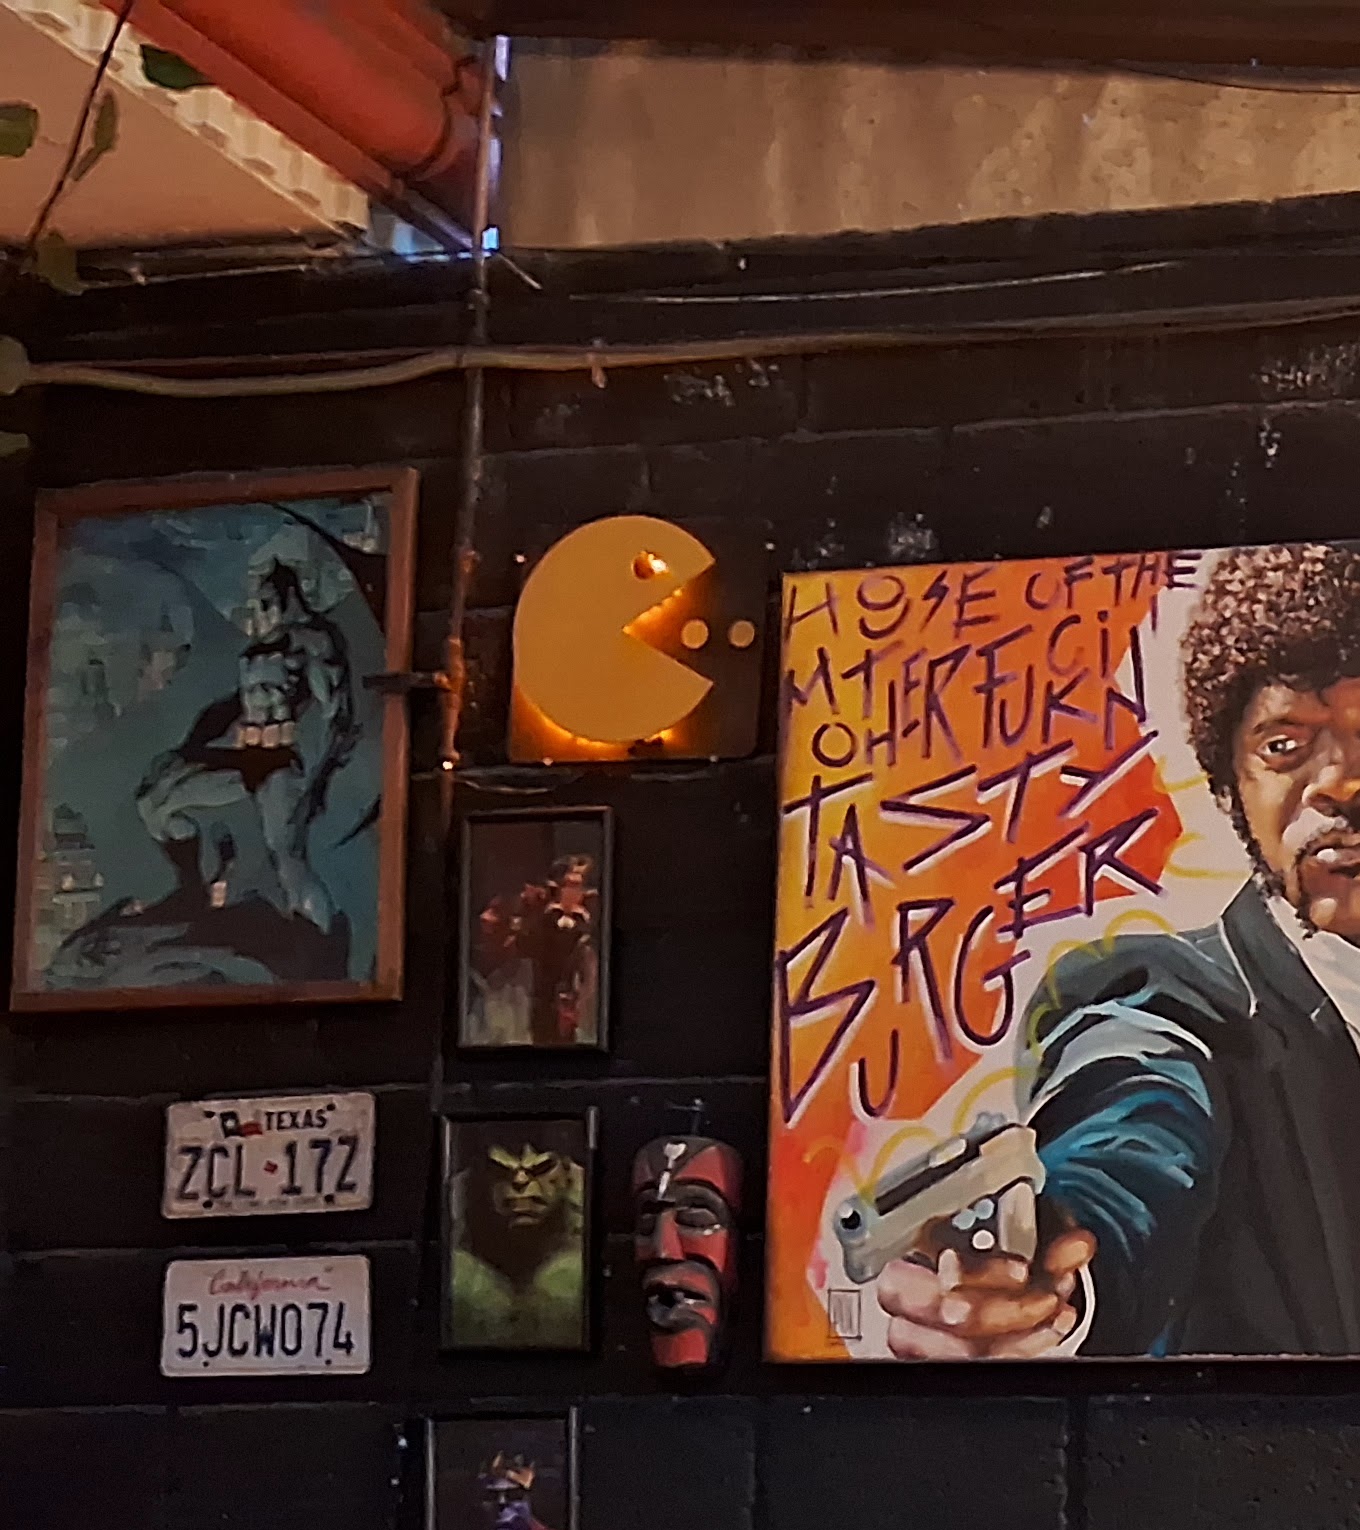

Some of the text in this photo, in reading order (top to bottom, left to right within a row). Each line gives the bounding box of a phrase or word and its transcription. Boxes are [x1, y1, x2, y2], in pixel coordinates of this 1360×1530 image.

[1024, 555, 1095, 610] OF
[1100, 551, 1203, 636] THE
[780, 729, 1160, 926] TASTY
[775, 807, 1168, 1127] BURGER
[264, 1108, 328, 1131] TEXAS
[177, 1143, 256, 1200] ZCL
